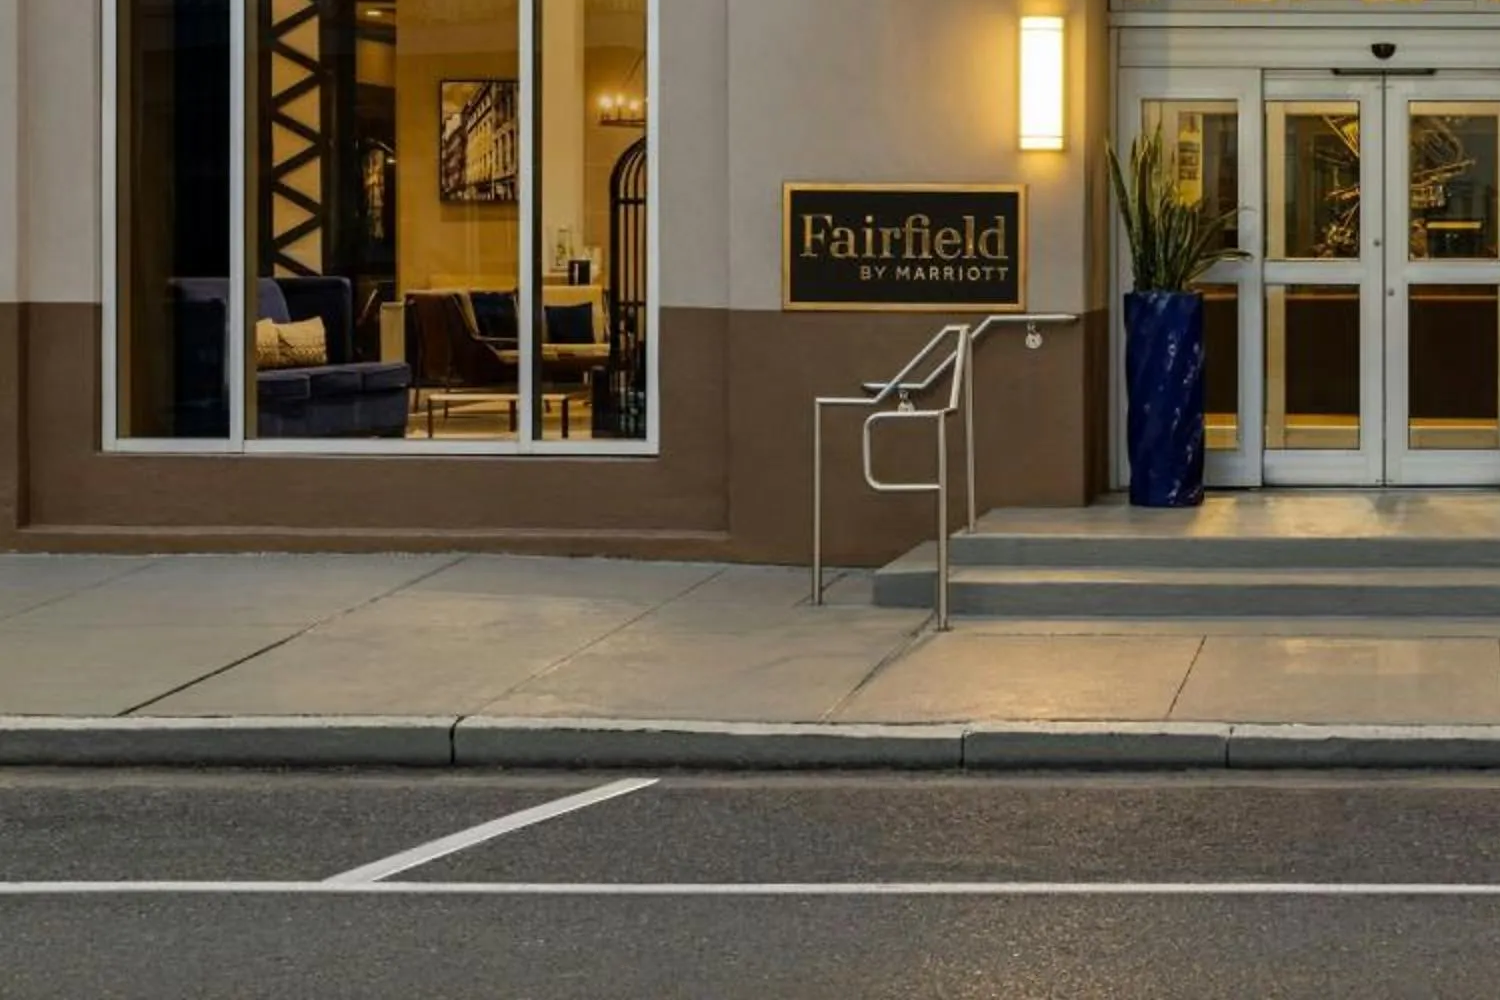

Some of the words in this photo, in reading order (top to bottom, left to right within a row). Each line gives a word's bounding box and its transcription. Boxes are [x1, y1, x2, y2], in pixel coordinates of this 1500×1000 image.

[800, 213, 1009, 259] Fairfield
[860, 265, 888, 281] BY
[896, 265, 1009, 282] MARRIOTT
